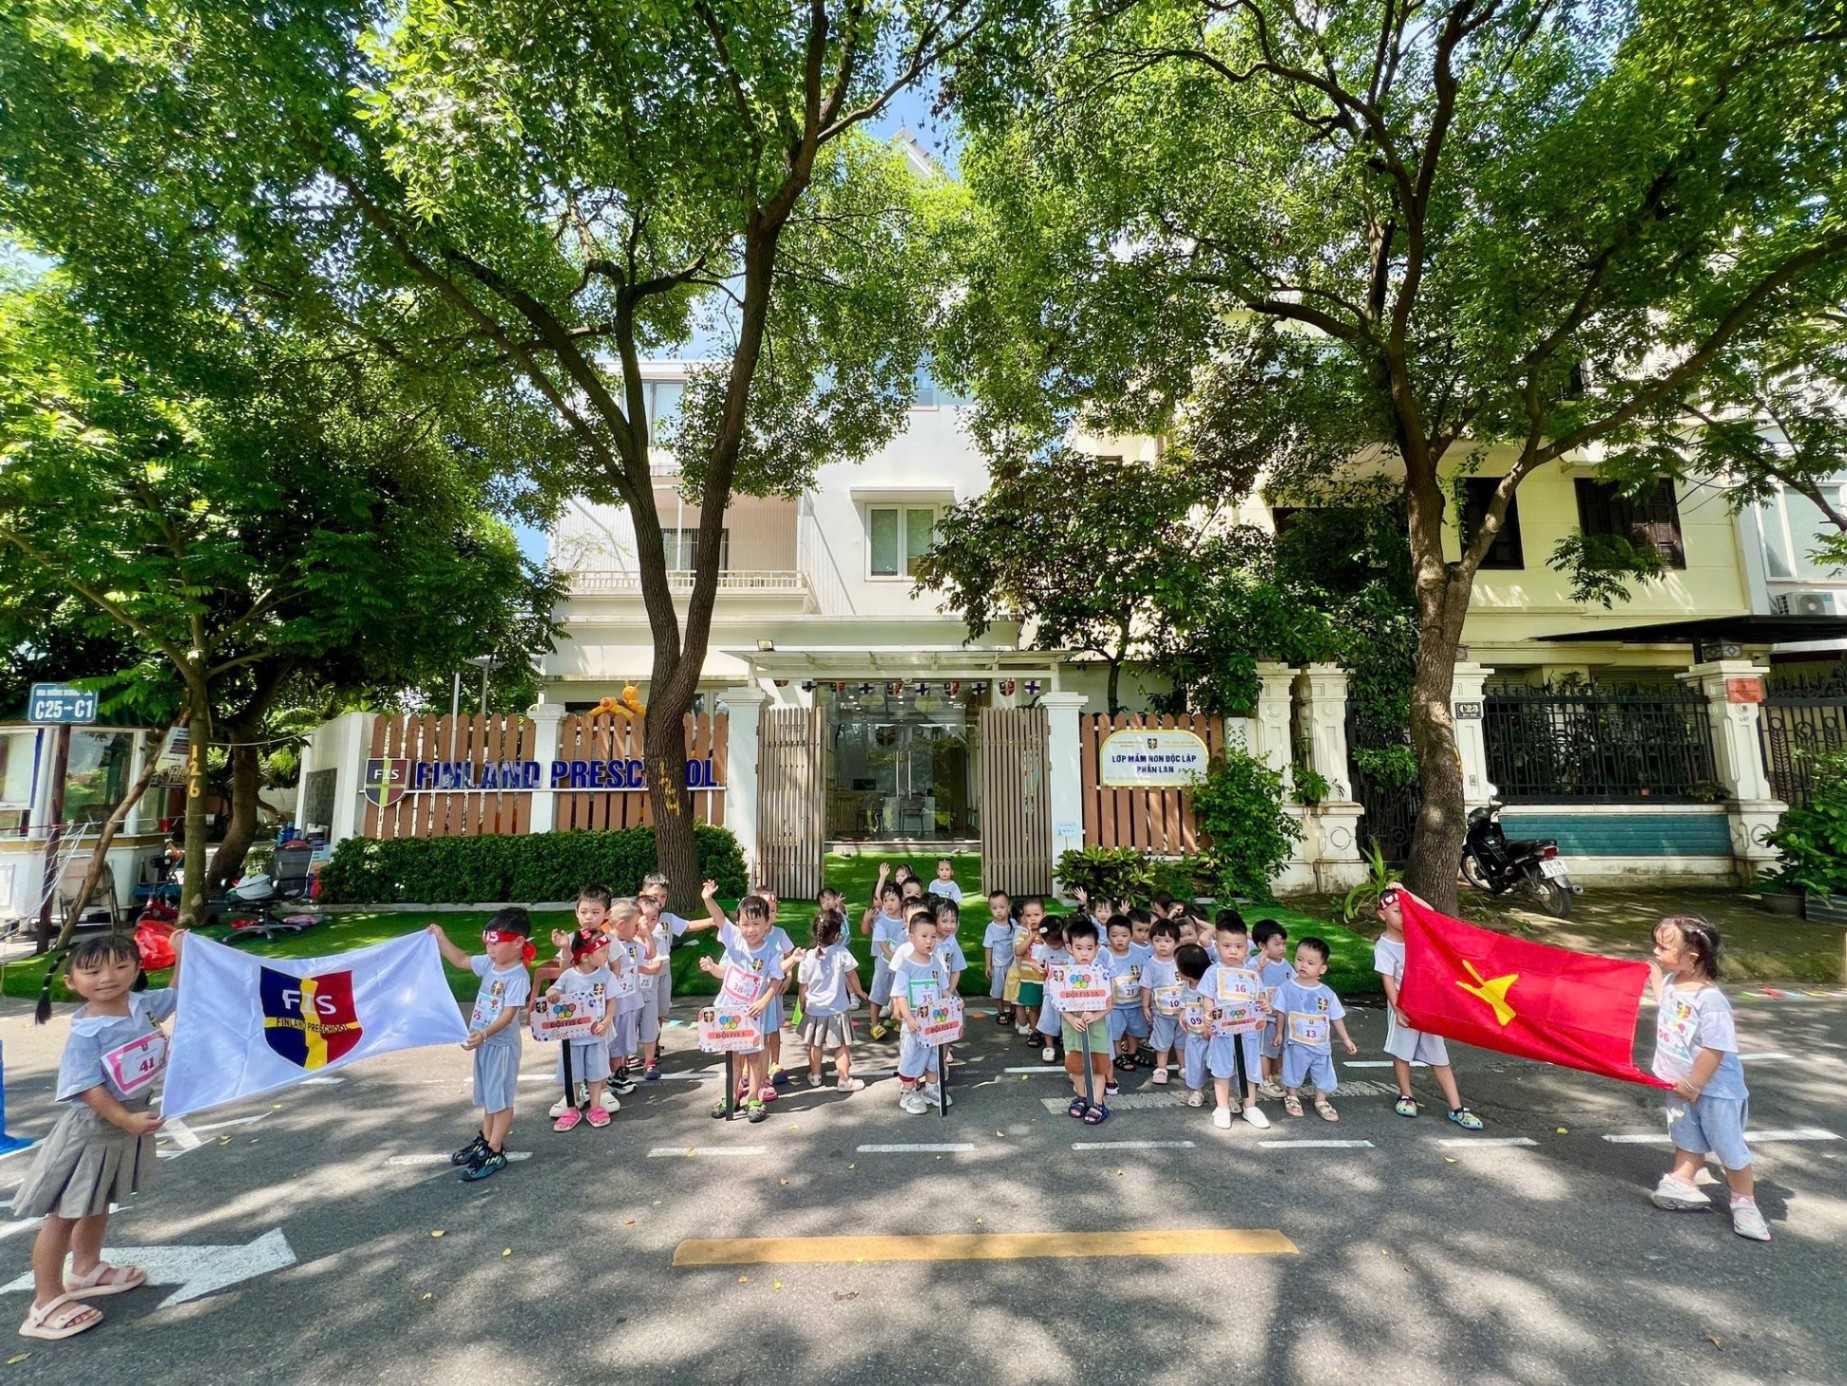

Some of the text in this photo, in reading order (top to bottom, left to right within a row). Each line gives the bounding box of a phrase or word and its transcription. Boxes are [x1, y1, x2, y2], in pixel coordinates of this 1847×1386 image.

[35, 700, 93, 720] C25 C1
[1149, 755, 1164, 763] NON
[189, 744, 202, 798] 126
[374, 768, 400, 780] FIS
[416, 759, 719, 789] FINLAND PRESCOL
[1235, 984, 1246, 993] 16
[282, 989, 337, 1015] FIS
[922, 994, 932, 1002] 35
[276, 1017, 349, 1034] FINLAND PRESCHOOL
[1190, 1017, 1202, 1025] 09
[1306, 1030, 1316, 1038] 13
[139, 1056, 154, 1072] 41
